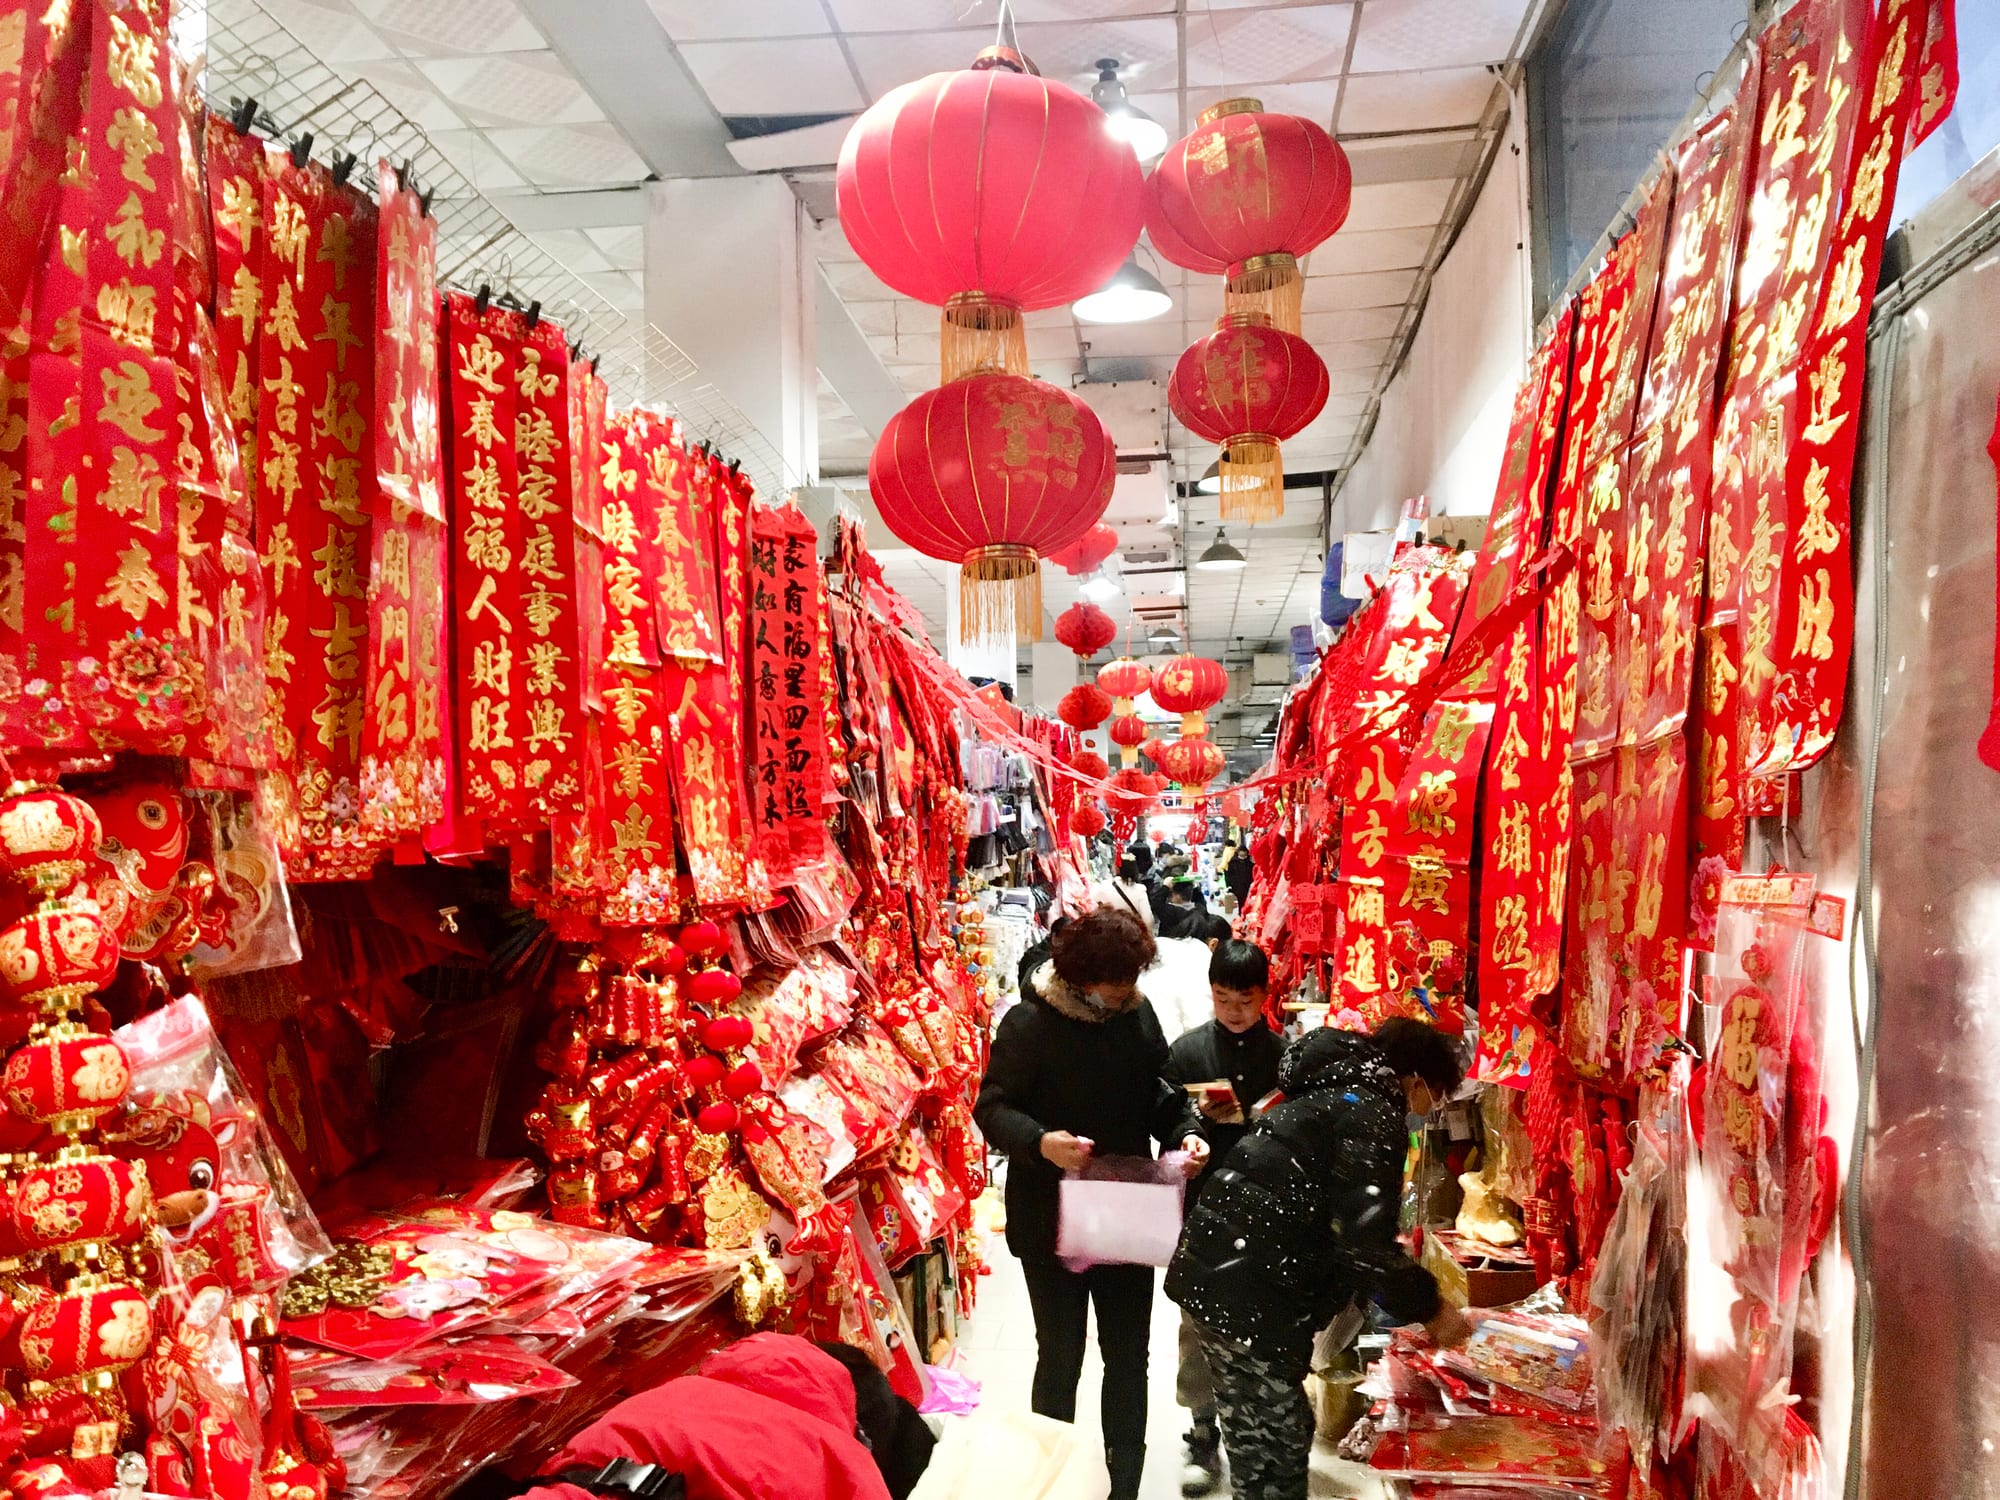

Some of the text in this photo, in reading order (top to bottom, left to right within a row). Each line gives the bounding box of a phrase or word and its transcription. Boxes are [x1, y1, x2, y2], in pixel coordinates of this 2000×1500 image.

[259, 186, 311, 763] 新春吉祥平安福
[310, 213, 371, 764] 牛年好運接吉祥
[375, 213, 416, 747] 牛年大吉開門紅
[457, 333, 514, 753] 迎春接福人財旺
[514, 347, 574, 754] 和睦家庭事業興
[600, 441, 662, 863] 和睦家庭事業興
[644, 443, 722, 846] 迎春接福人財旺
[784, 535, 813, 819] 家有福星四面照
